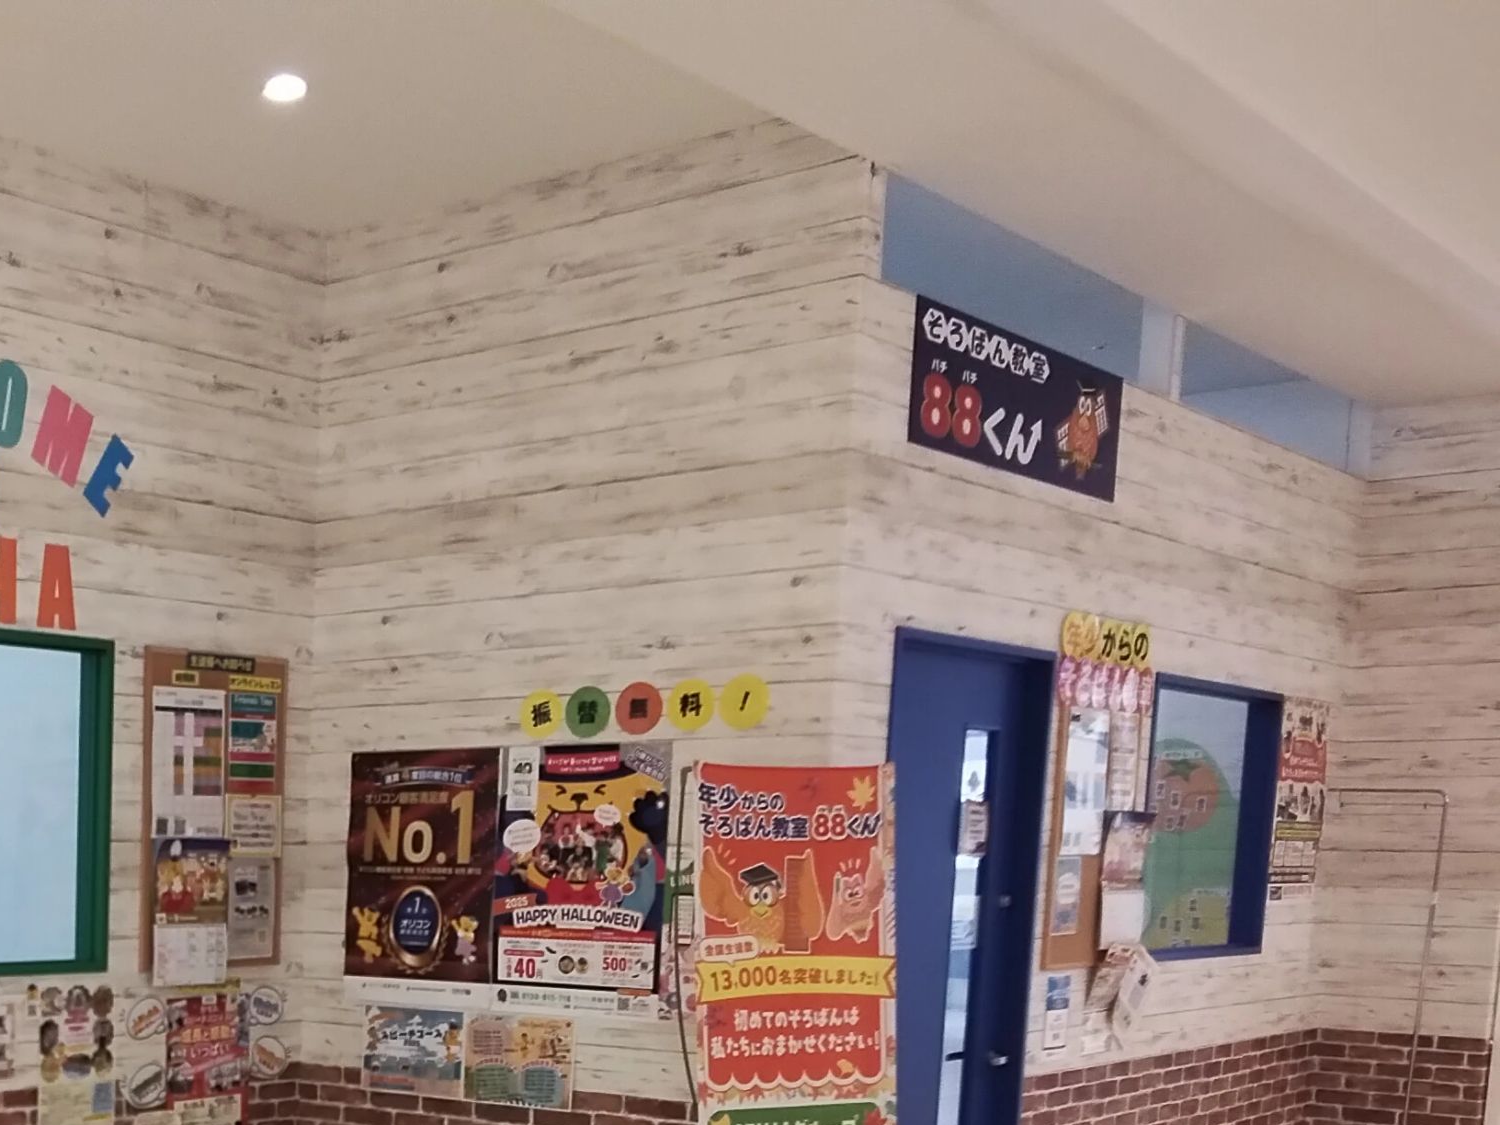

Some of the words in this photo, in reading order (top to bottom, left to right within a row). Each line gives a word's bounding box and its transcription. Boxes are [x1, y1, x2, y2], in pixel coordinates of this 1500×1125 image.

[923, 308, 1051, 384] そろばん教室
[920, 372, 1043, 465] 88くん
[699, 783, 784, 812] 年少からの
[363, 790, 475, 866] No.1
[699, 813, 810, 839] そろばん教室
[516, 908, 558, 925] HAPPY
[561, 907, 640, 929] HALLOWEEN
[602, 957, 627, 972] 500
[734, 1006, 860, 1032] 初めてのそろばんは
[710, 1029, 881, 1059] 私たちにおまかせください！
